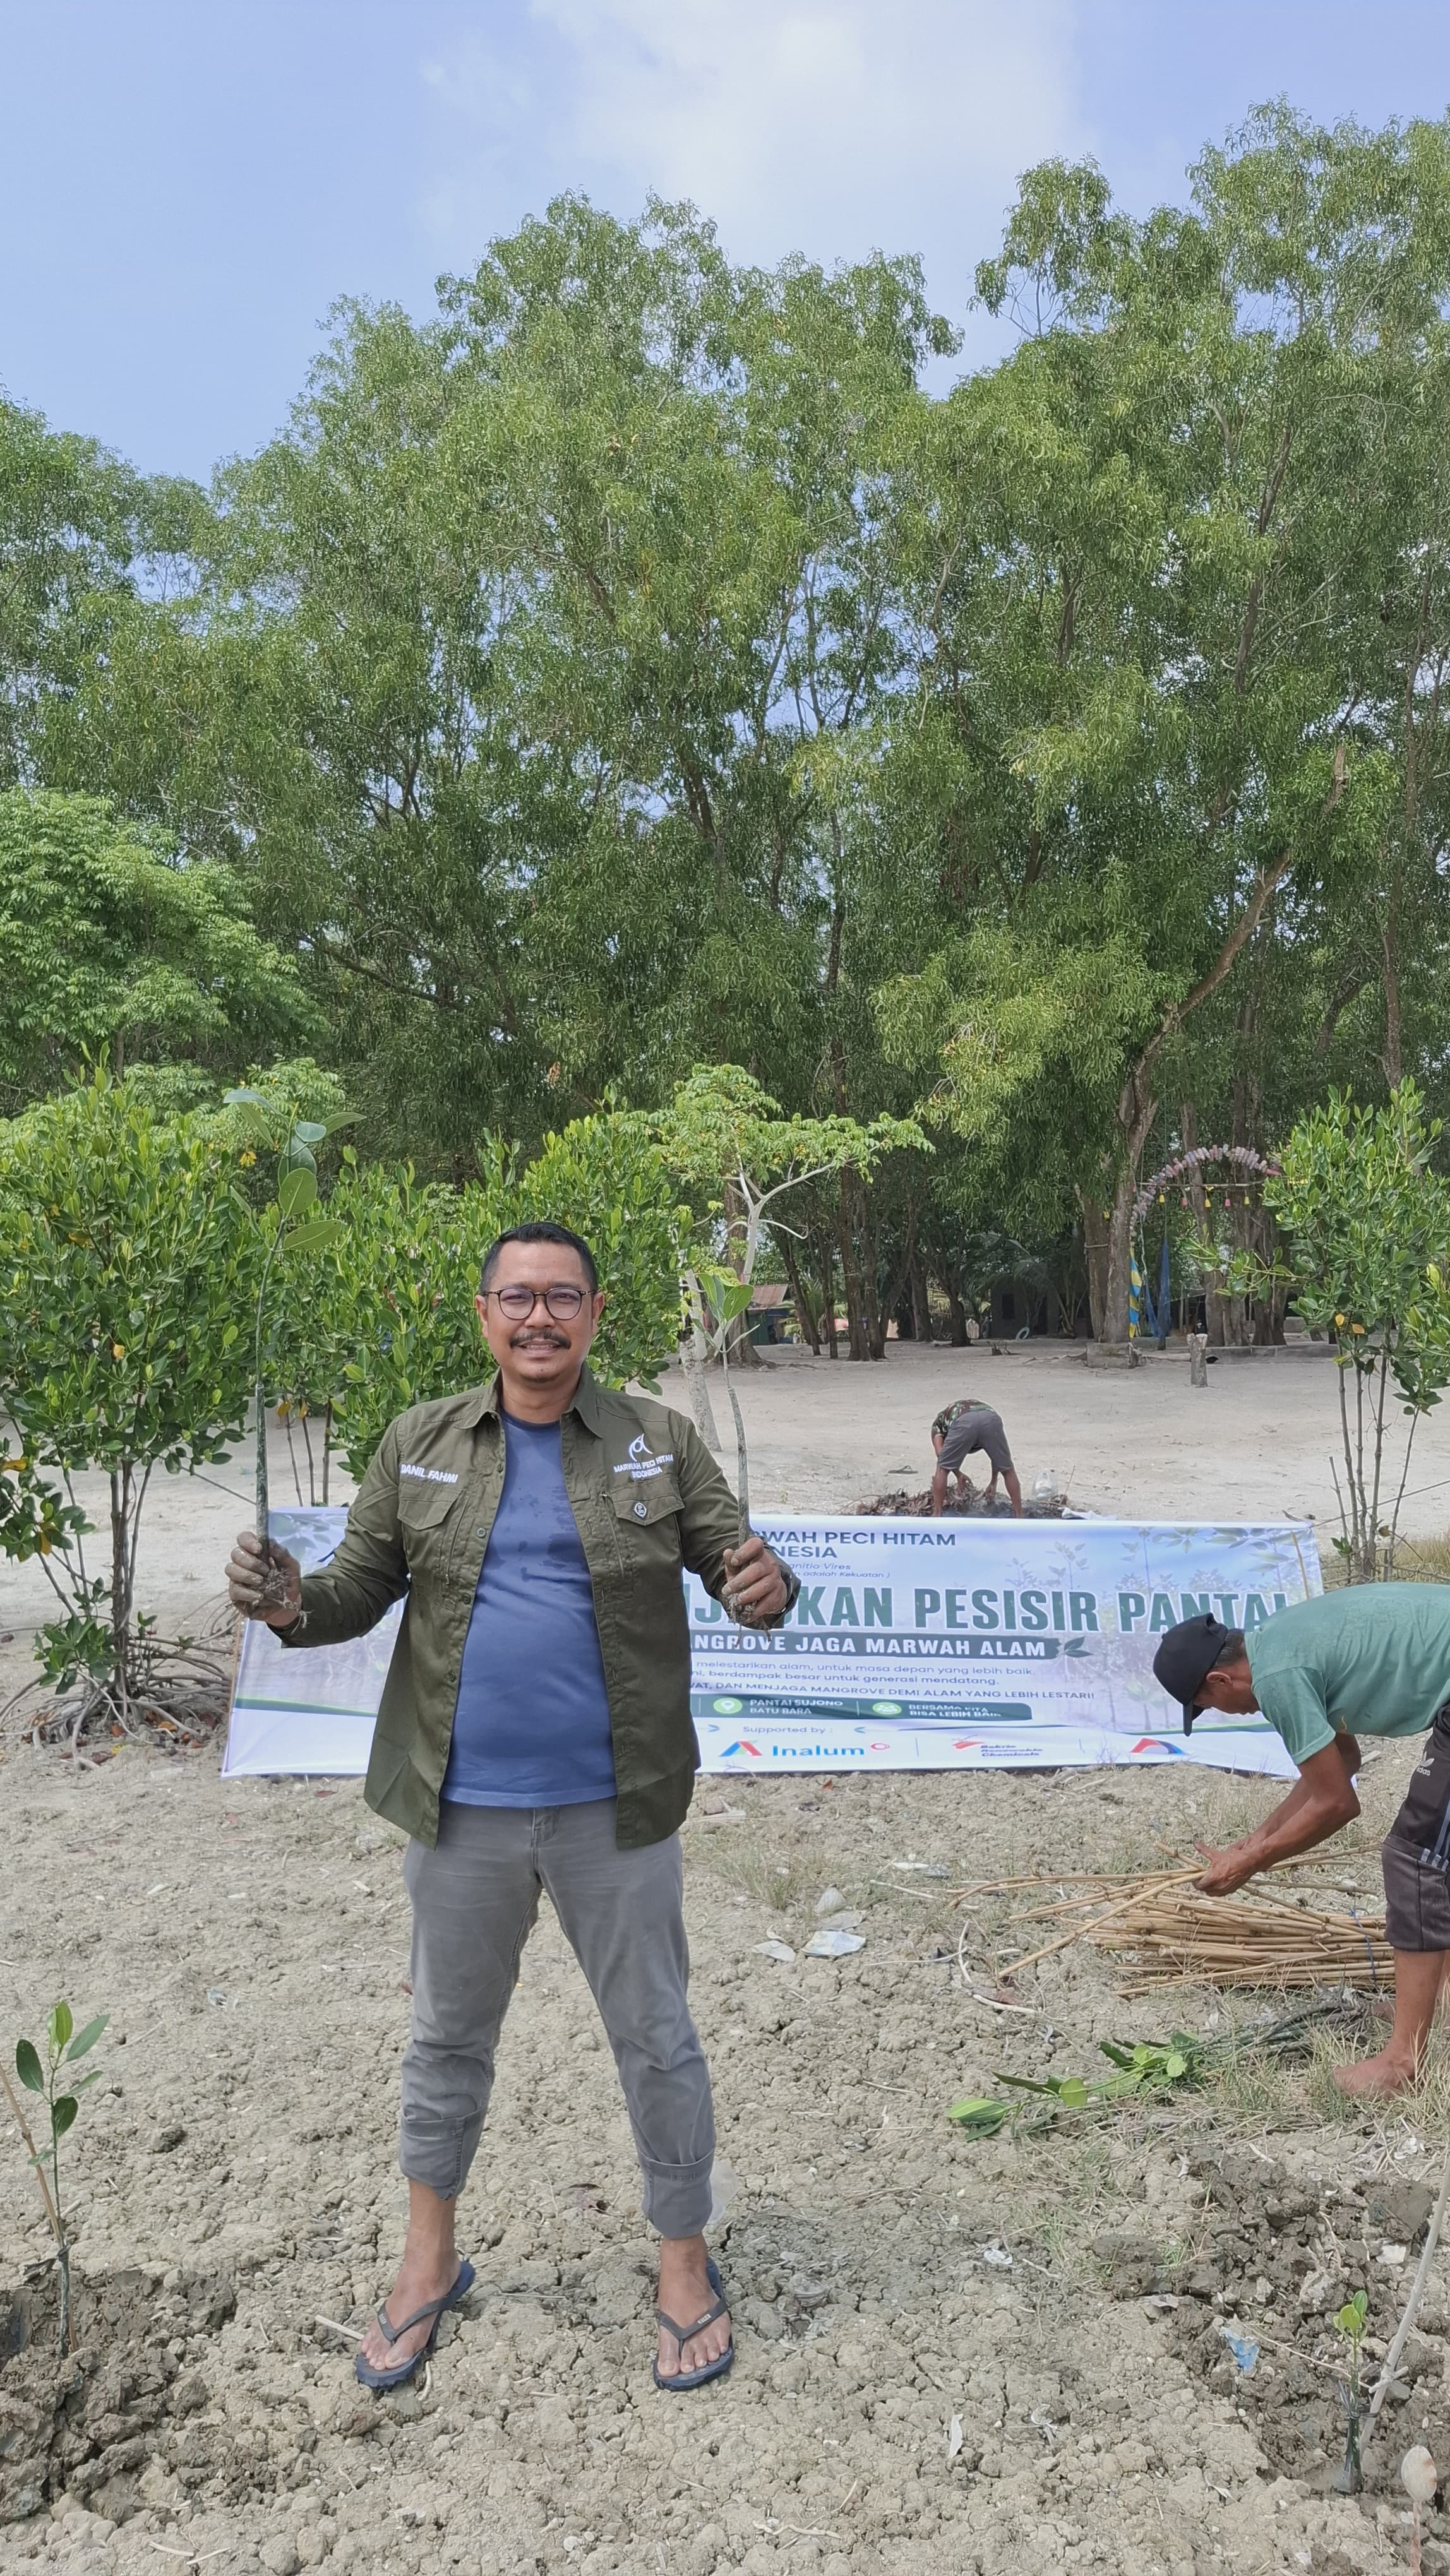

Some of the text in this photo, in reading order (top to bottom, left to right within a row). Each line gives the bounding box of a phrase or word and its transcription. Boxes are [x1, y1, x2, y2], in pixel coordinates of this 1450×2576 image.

[642, 1459, 656, 1469] PECI
[655, 1454, 674, 1464] HITAM
[400, 1464, 458, 1483] DANIL FAHMI
[632, 1466, 662, 1478] INDONESIA
[755, 1531, 956, 1546] WAH PECI HITAM
[774, 1546, 837, 1558] NESIA
[914, 1587, 1100, 1631] PESISIR
[694, 1634, 1045, 1657] NGROVE JAGA MARWAH ALAM
[697, 1661, 776, 1669] melestarikan
[894, 1666, 934, 1674] depan
[938, 1667, 968, 1675] yang
[973, 1666, 1002, 1674] lebih
[709, 1671, 781, 1679] berdampak
[863, 1675, 917, 1683] generasi
[921, 1676, 1000, 1685] mendatang.
[746, 1684, 807, 1692] MENJAGA
[812, 1686, 885, 1695] MANGROVE
[772, 1744, 865, 1756] Inalum
